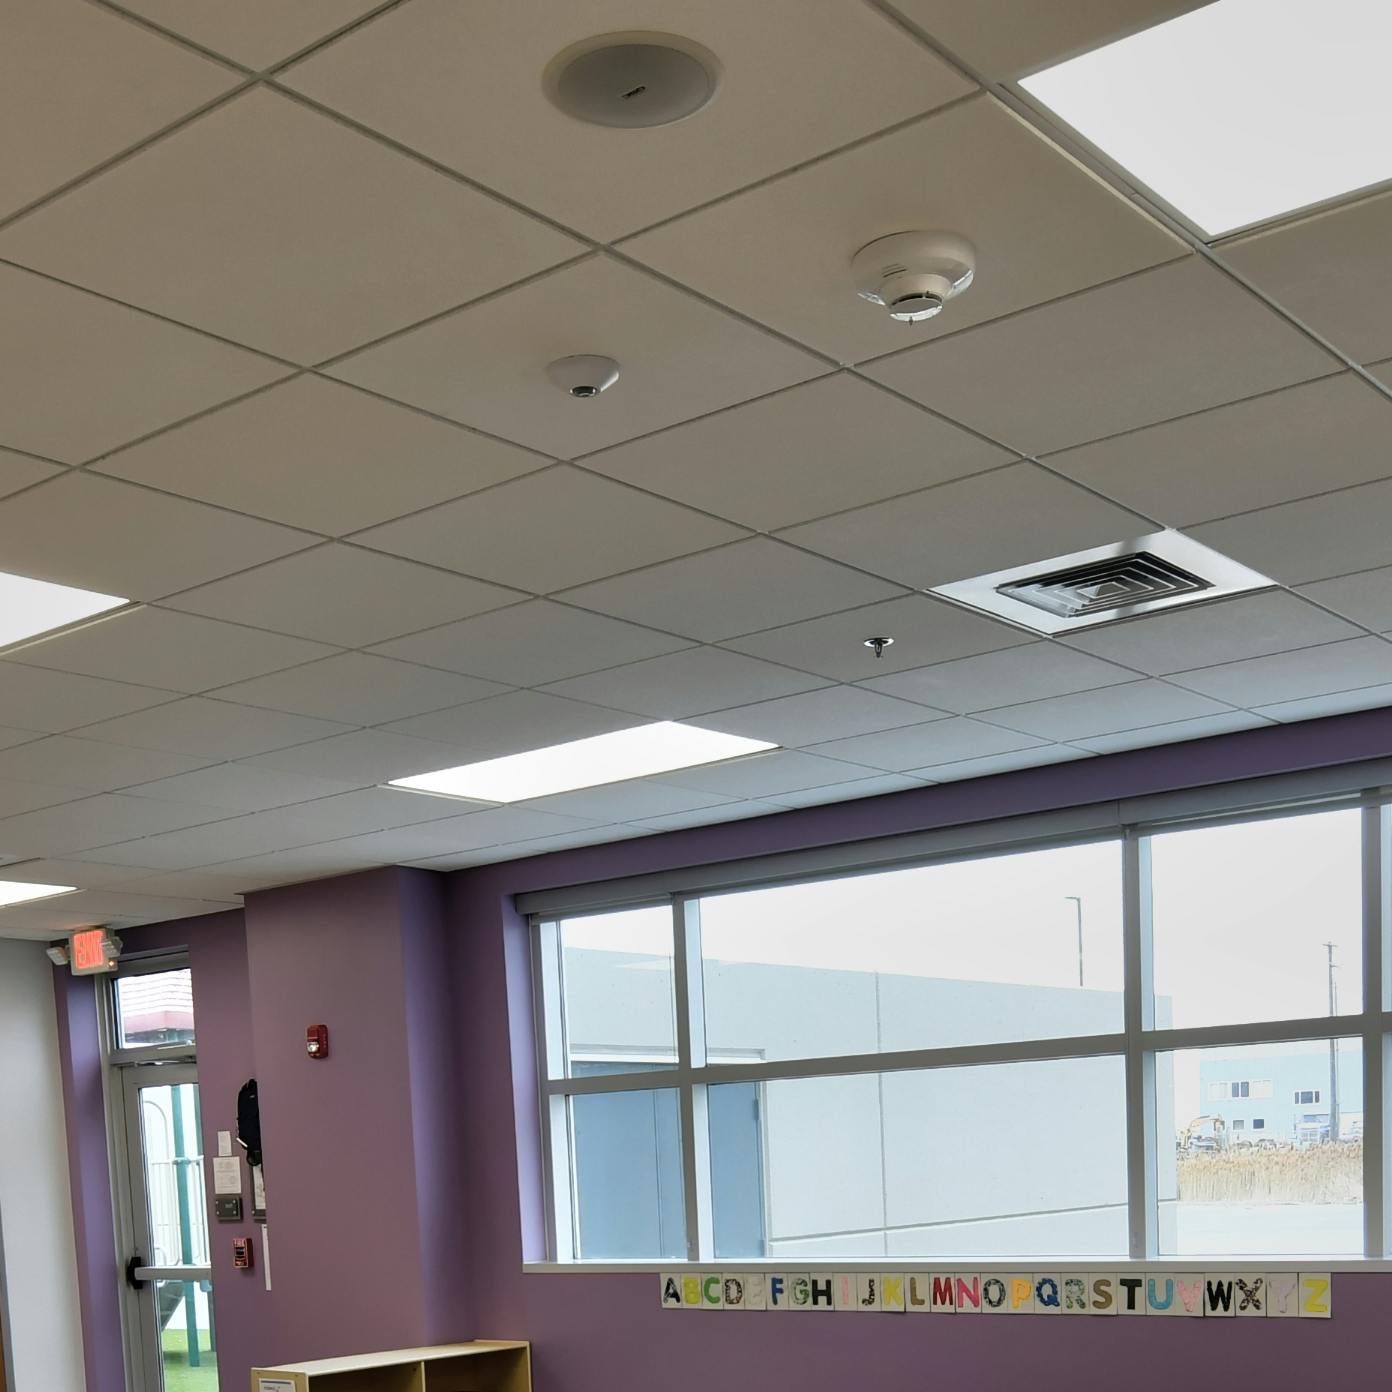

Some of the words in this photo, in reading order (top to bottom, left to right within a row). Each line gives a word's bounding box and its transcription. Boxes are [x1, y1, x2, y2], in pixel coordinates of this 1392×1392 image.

[663, 1277, 681, 1304] A
[683, 1277, 700, 1305] B
[704, 1276, 721, 1304] C
[724, 1278, 743, 1305] D
[771, 1277, 784, 1306] F
[793, 1278, 809, 1305] G
[812, 1279, 832, 1306] H
[841, 1276, 849, 1305] I
[862, 1278, 875, 1306] J
[883, 1277, 904, 1306] K
[910, 1277, 925, 1306] L
[932, 1277, 954, 1306] M
[956, 1277, 980, 1308] N
[983, 1278, 1006, 1307] O
[1011, 1279, 1033, 1309] P
[1036, 1278, 1060, 1307] Q
[1065, 1278, 1087, 1309] R
[1092, 1279, 1113, 1309] S
[1119, 1278, 1143, 1310] T
[1147, 1278, 1174, 1310] U
[1176, 1279, 1202, 1313] V
[1207, 1279, 1233, 1312] W
[1235, 1278, 1263, 1311] X
[1268, 1279, 1296, 1313] Y
[1302, 1279, 1329, 1313] Z
